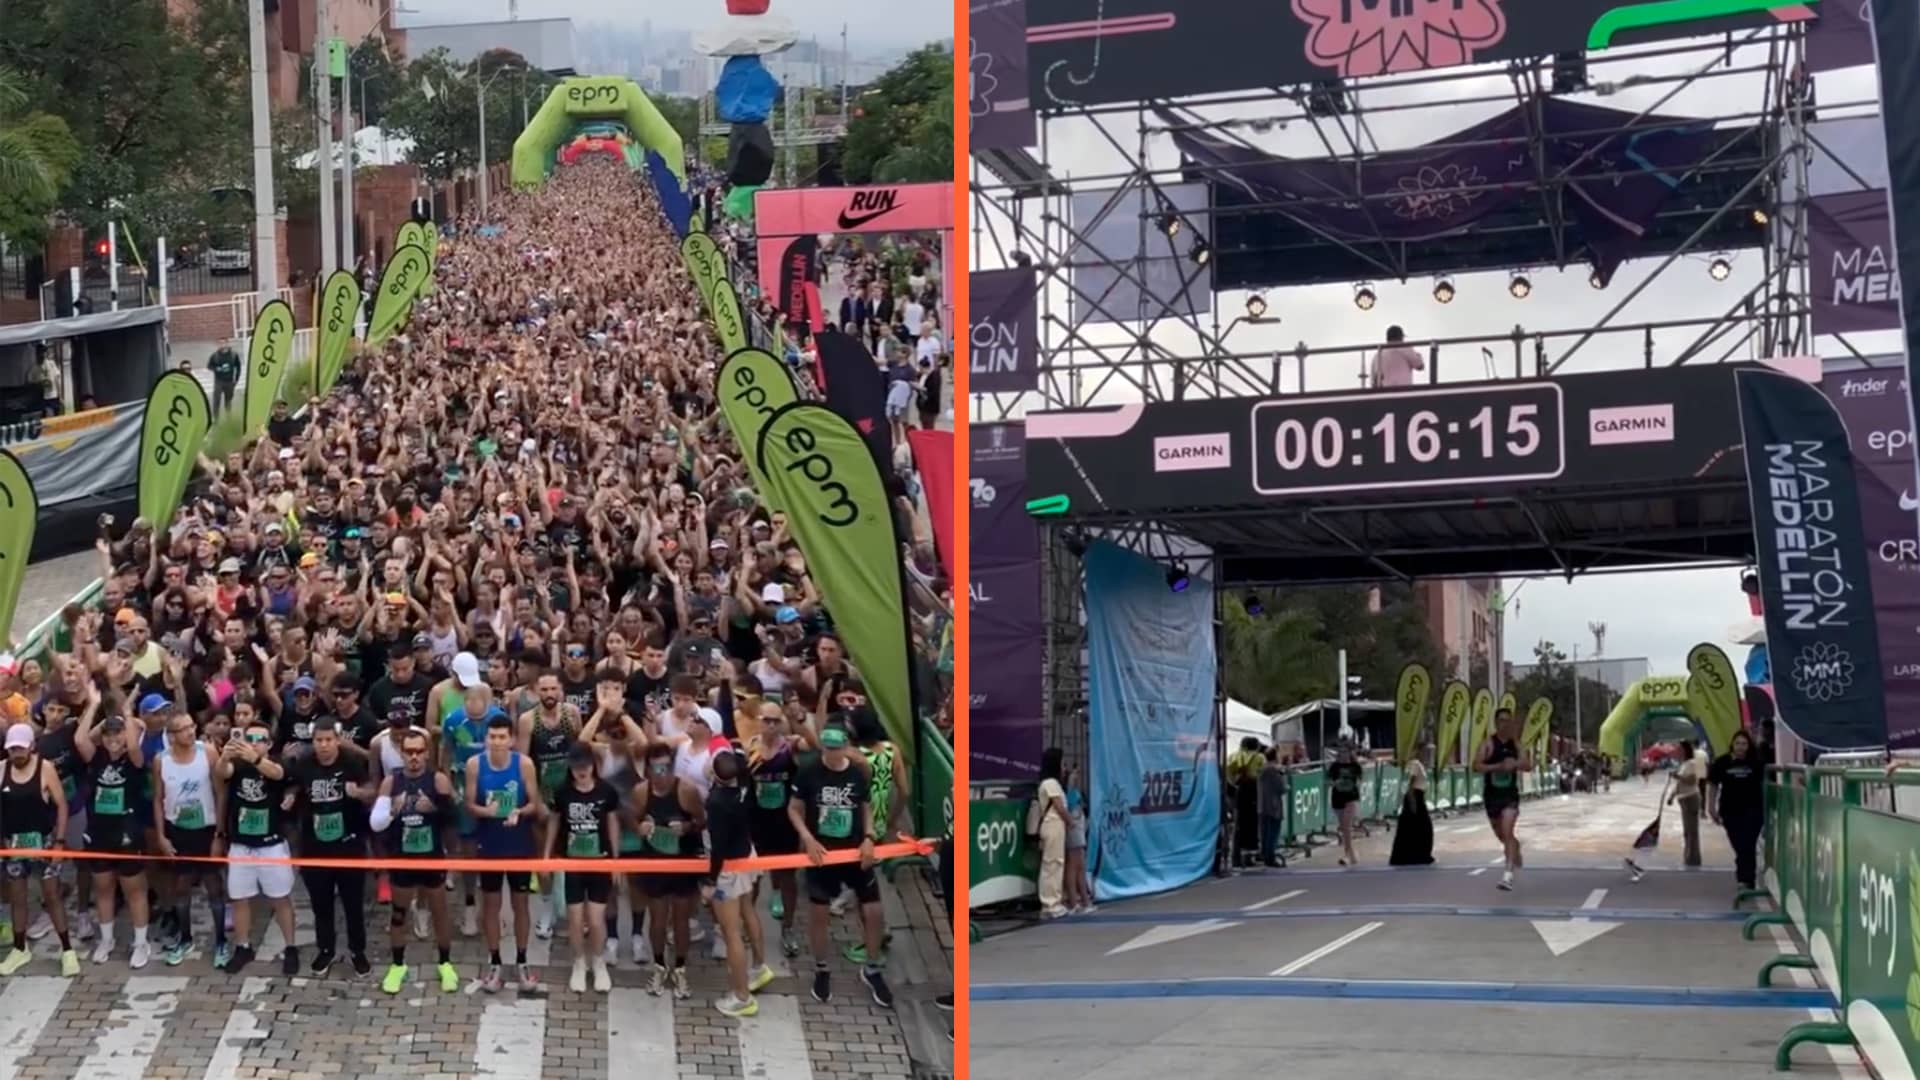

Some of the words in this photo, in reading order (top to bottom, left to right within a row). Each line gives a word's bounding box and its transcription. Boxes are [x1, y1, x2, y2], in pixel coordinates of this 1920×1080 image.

[568, 85, 620, 107] epm
[850, 189, 898, 212] RUN
[388, 258, 420, 296] epm
[689, 239, 712, 277] epm
[328, 285, 351, 333] epm
[717, 291, 738, 337] epm
[257, 318, 285, 378] epm
[969, 315, 1019, 348] ÓN
[154, 394, 193, 467] epm
[1275, 403, 1541, 471] 00:16:15
[1594, 416, 1667, 433] GARMIN
[1868, 429, 1913, 457] ep
[1158, 445, 1224, 460] GARMIN
[785, 427, 859, 527] epm
[1764, 443, 1823, 630] MEDELLÍN
[1793, 439, 1853, 626] MARATÓN
[1641, 681, 1681, 698] epm
[1696, 653, 1725, 690] epm
[1803, 661, 1842, 682] MM
[1402, 674, 1423, 713] epm
[1446, 690, 1464, 723] epm
[1142, 770, 1184, 807] 2025
[1295, 786, 1320, 825] epm
[976, 820, 1018, 865] epm
[1859, 862, 1897, 977] epm
